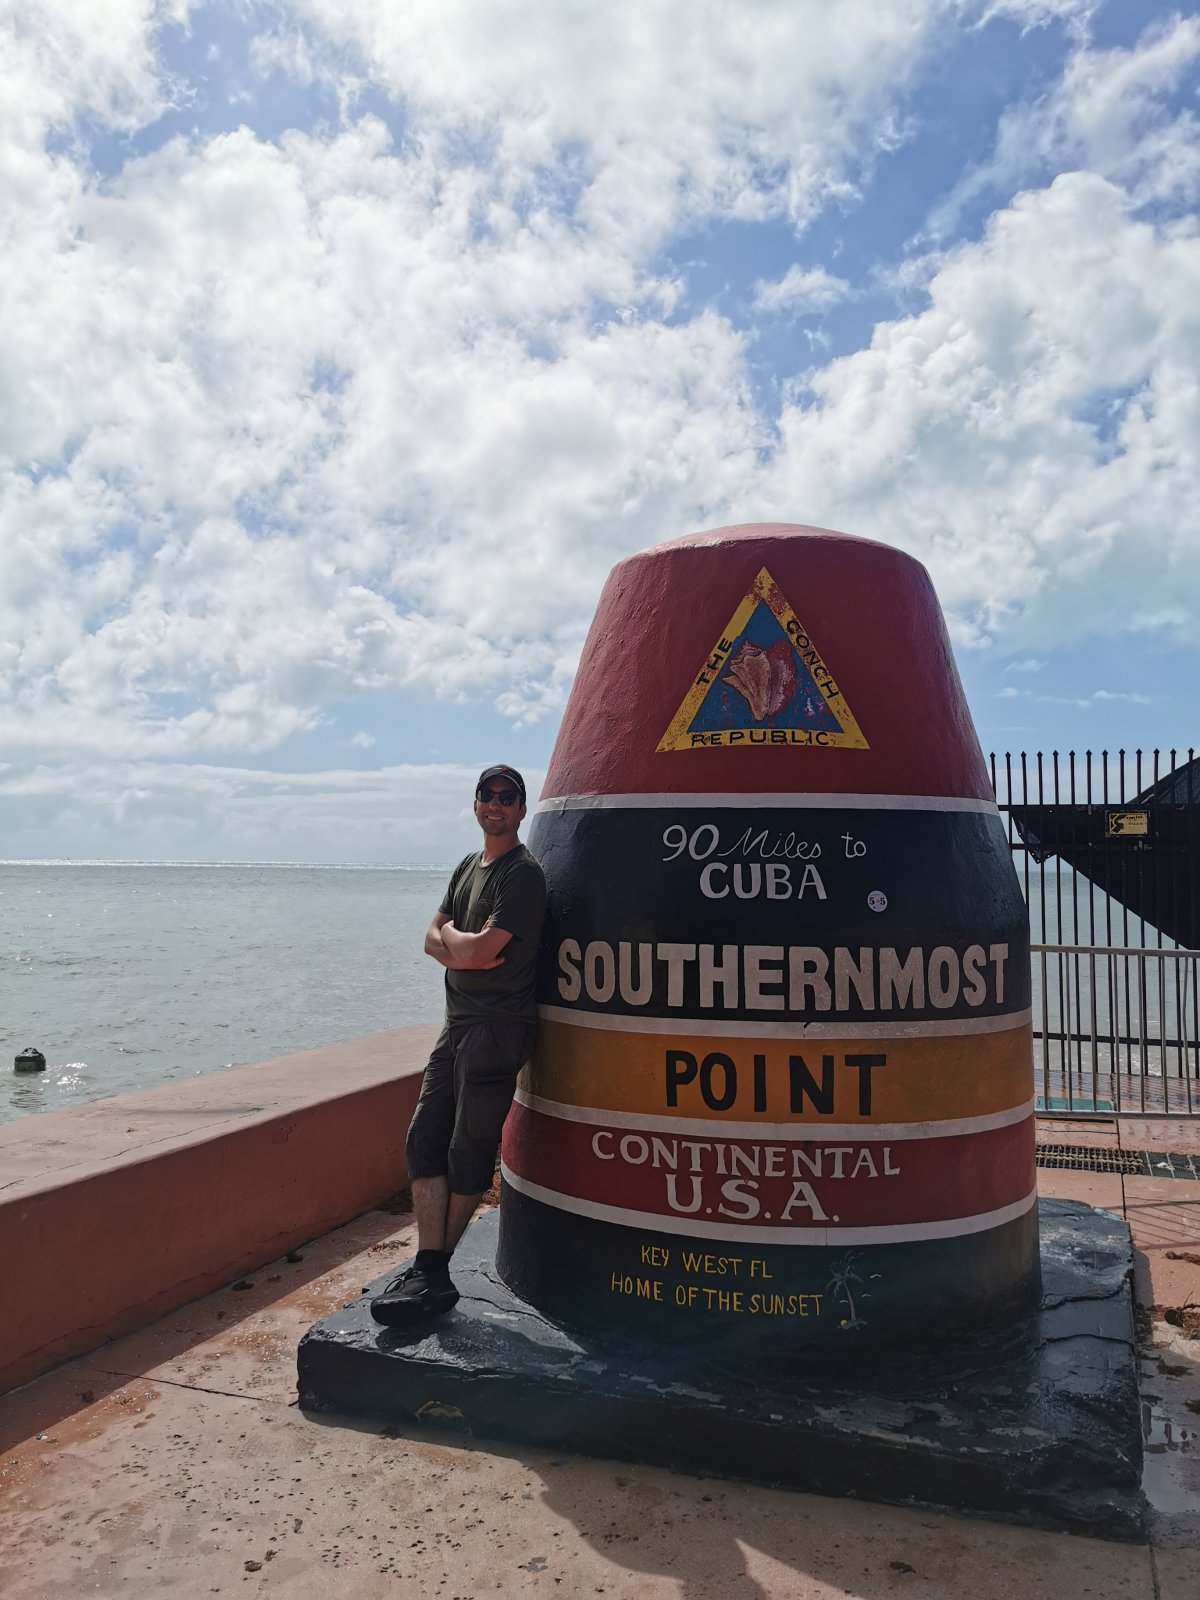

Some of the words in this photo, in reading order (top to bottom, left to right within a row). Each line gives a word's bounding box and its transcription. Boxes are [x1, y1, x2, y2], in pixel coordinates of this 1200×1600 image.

[696, 637, 733, 686] THE
[786, 619, 839, 700] CONCH
[691, 730, 830, 747] REPUBLIC
[662, 824, 719, 861] 90
[718, 826, 822, 860] Miles
[841, 831, 867, 859] to
[700, 863, 827, 900] CUBA
[557, 938, 1009, 1012] SOUTHERNMOST
[665, 1050, 887, 1116] POINT
[591, 1131, 901, 1179] CONTINENTAL
[665, 1173, 841, 1223] U.S.A.
[641, 1245, 670, 1268] KEY
[682, 1252, 743, 1278] WEST
[750, 1259, 773, 1279] FL
[611, 1272, 664, 1302] HOME
[675, 1284, 700, 1308] OF
[698, 1287, 745, 1313] THE
[749, 1293, 824, 1317] SUNSET
